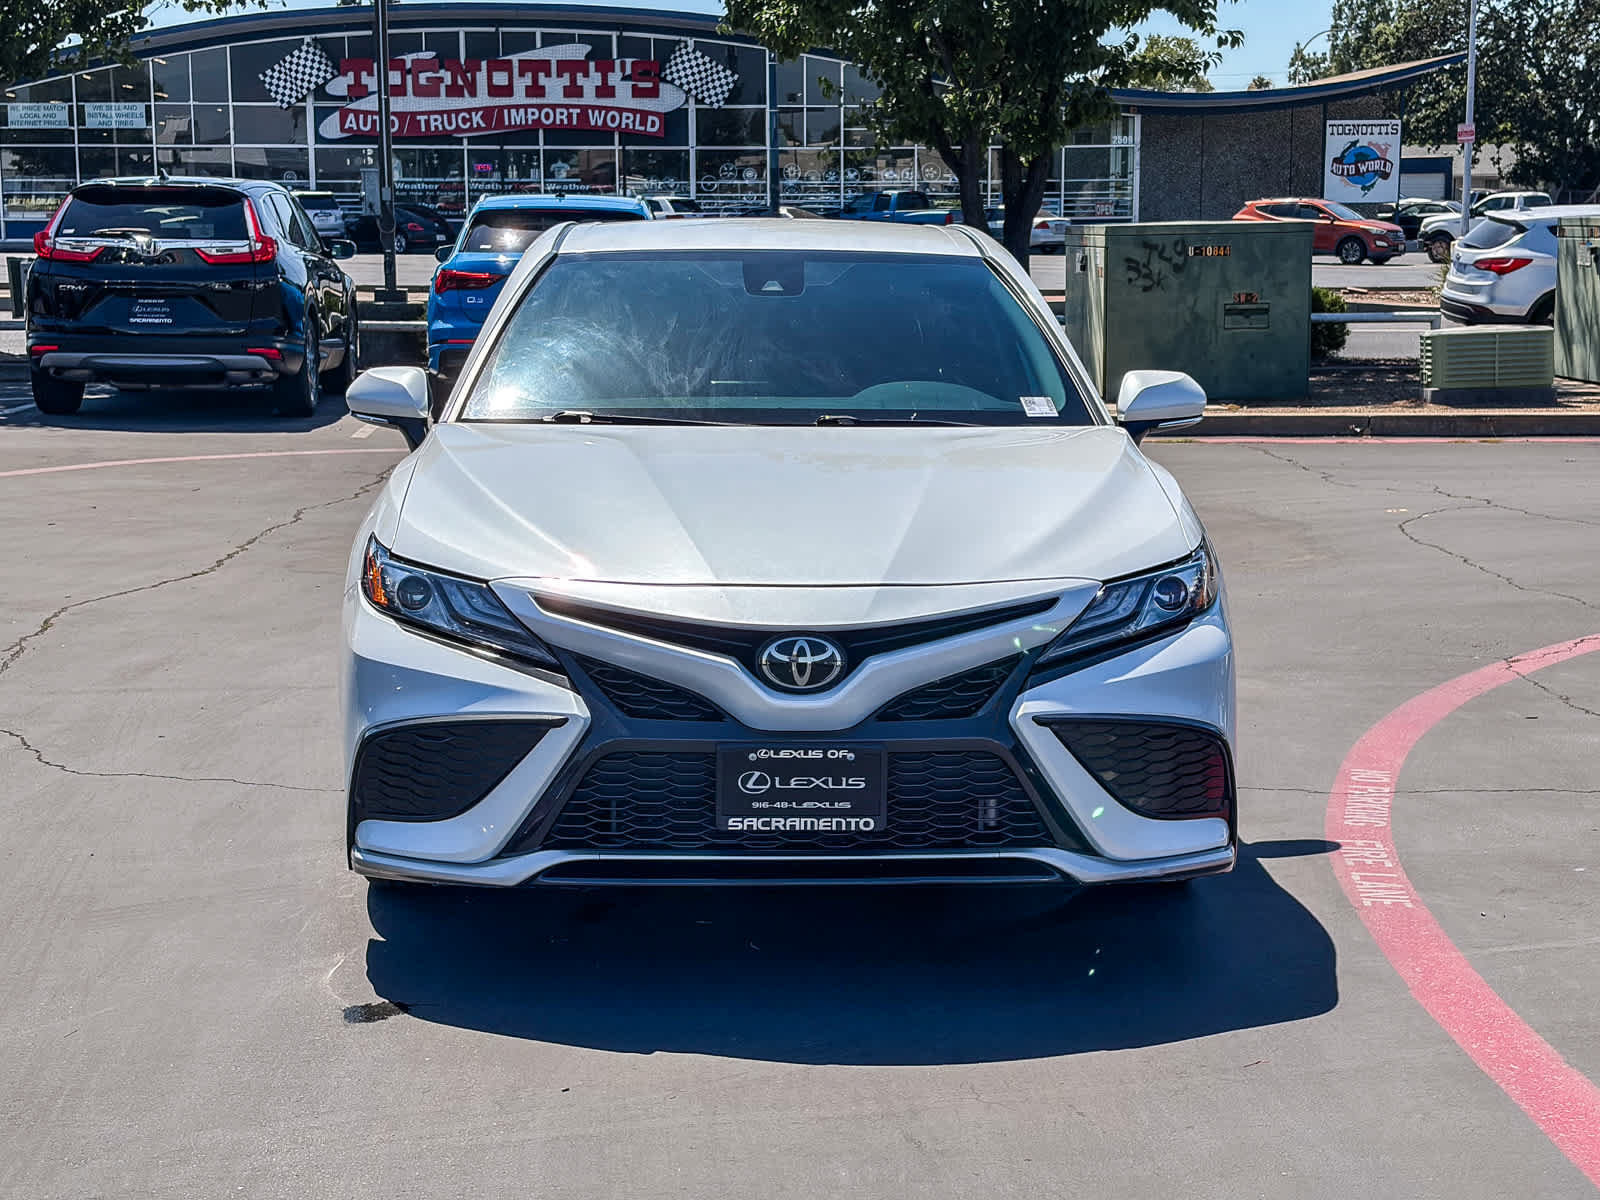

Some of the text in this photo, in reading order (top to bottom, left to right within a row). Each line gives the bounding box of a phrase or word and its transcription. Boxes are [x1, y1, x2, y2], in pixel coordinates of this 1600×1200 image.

[340, 58, 660, 99] TOGNOTTI'S
[344, 112, 399, 132] AUTO
[416, 111, 486, 132] TRUCK
[503, 108, 581, 126] IMPORT
[588, 109, 661, 133] WORLD
[1328, 122, 1400, 136] TOGNOTTI'S
[1332, 160, 1393, 175] AUTO WORLD
[1096, 203, 1115, 216] OPEN
[770, 749, 849, 759] LEXUS OF
[774, 776, 866, 789] LEXUS
[1343, 784, 1391, 828] PARKING
[727, 817, 876, 832] SACRAMENTO
[1335, 839, 1393, 868] FIRE
[1350, 871, 1414, 908] LANE
